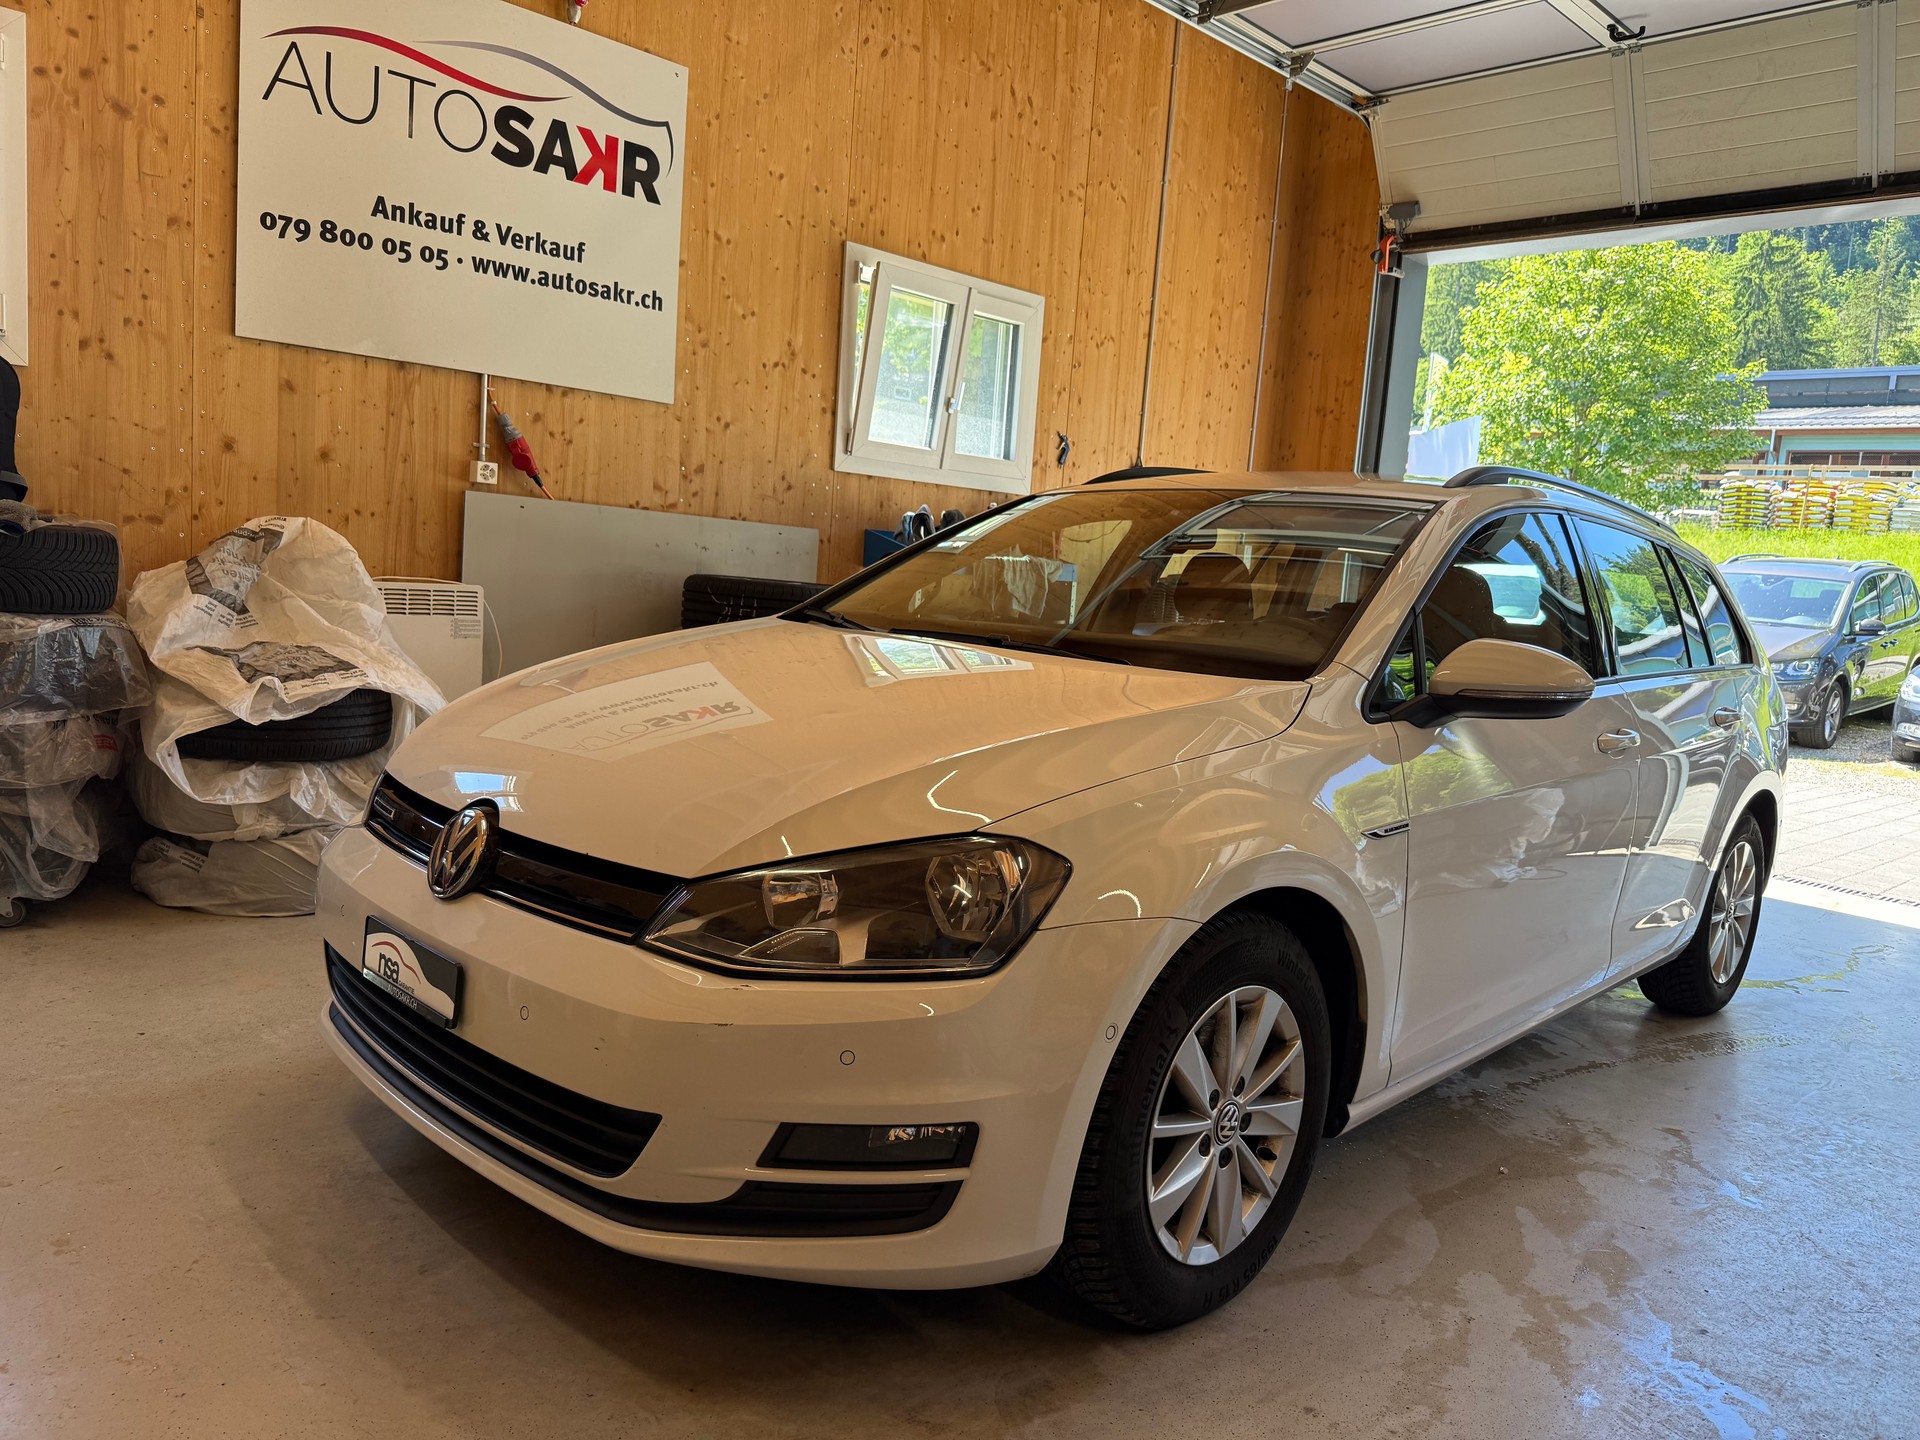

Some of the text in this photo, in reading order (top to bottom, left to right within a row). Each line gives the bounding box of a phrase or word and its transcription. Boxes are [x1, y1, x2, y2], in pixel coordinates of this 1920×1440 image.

[262, 41, 661, 206] AUTOSAKR
[260, 211, 311, 243] 079
[319, 220, 373, 251] 800
[381, 237, 412, 263] 05
[420, 246, 449, 271] 05
[471, 254, 664, 313] www.autosakr.ch
[371, 195, 586, 263] Ankauf & Verkauf
[378, 952, 400, 984] nsa
